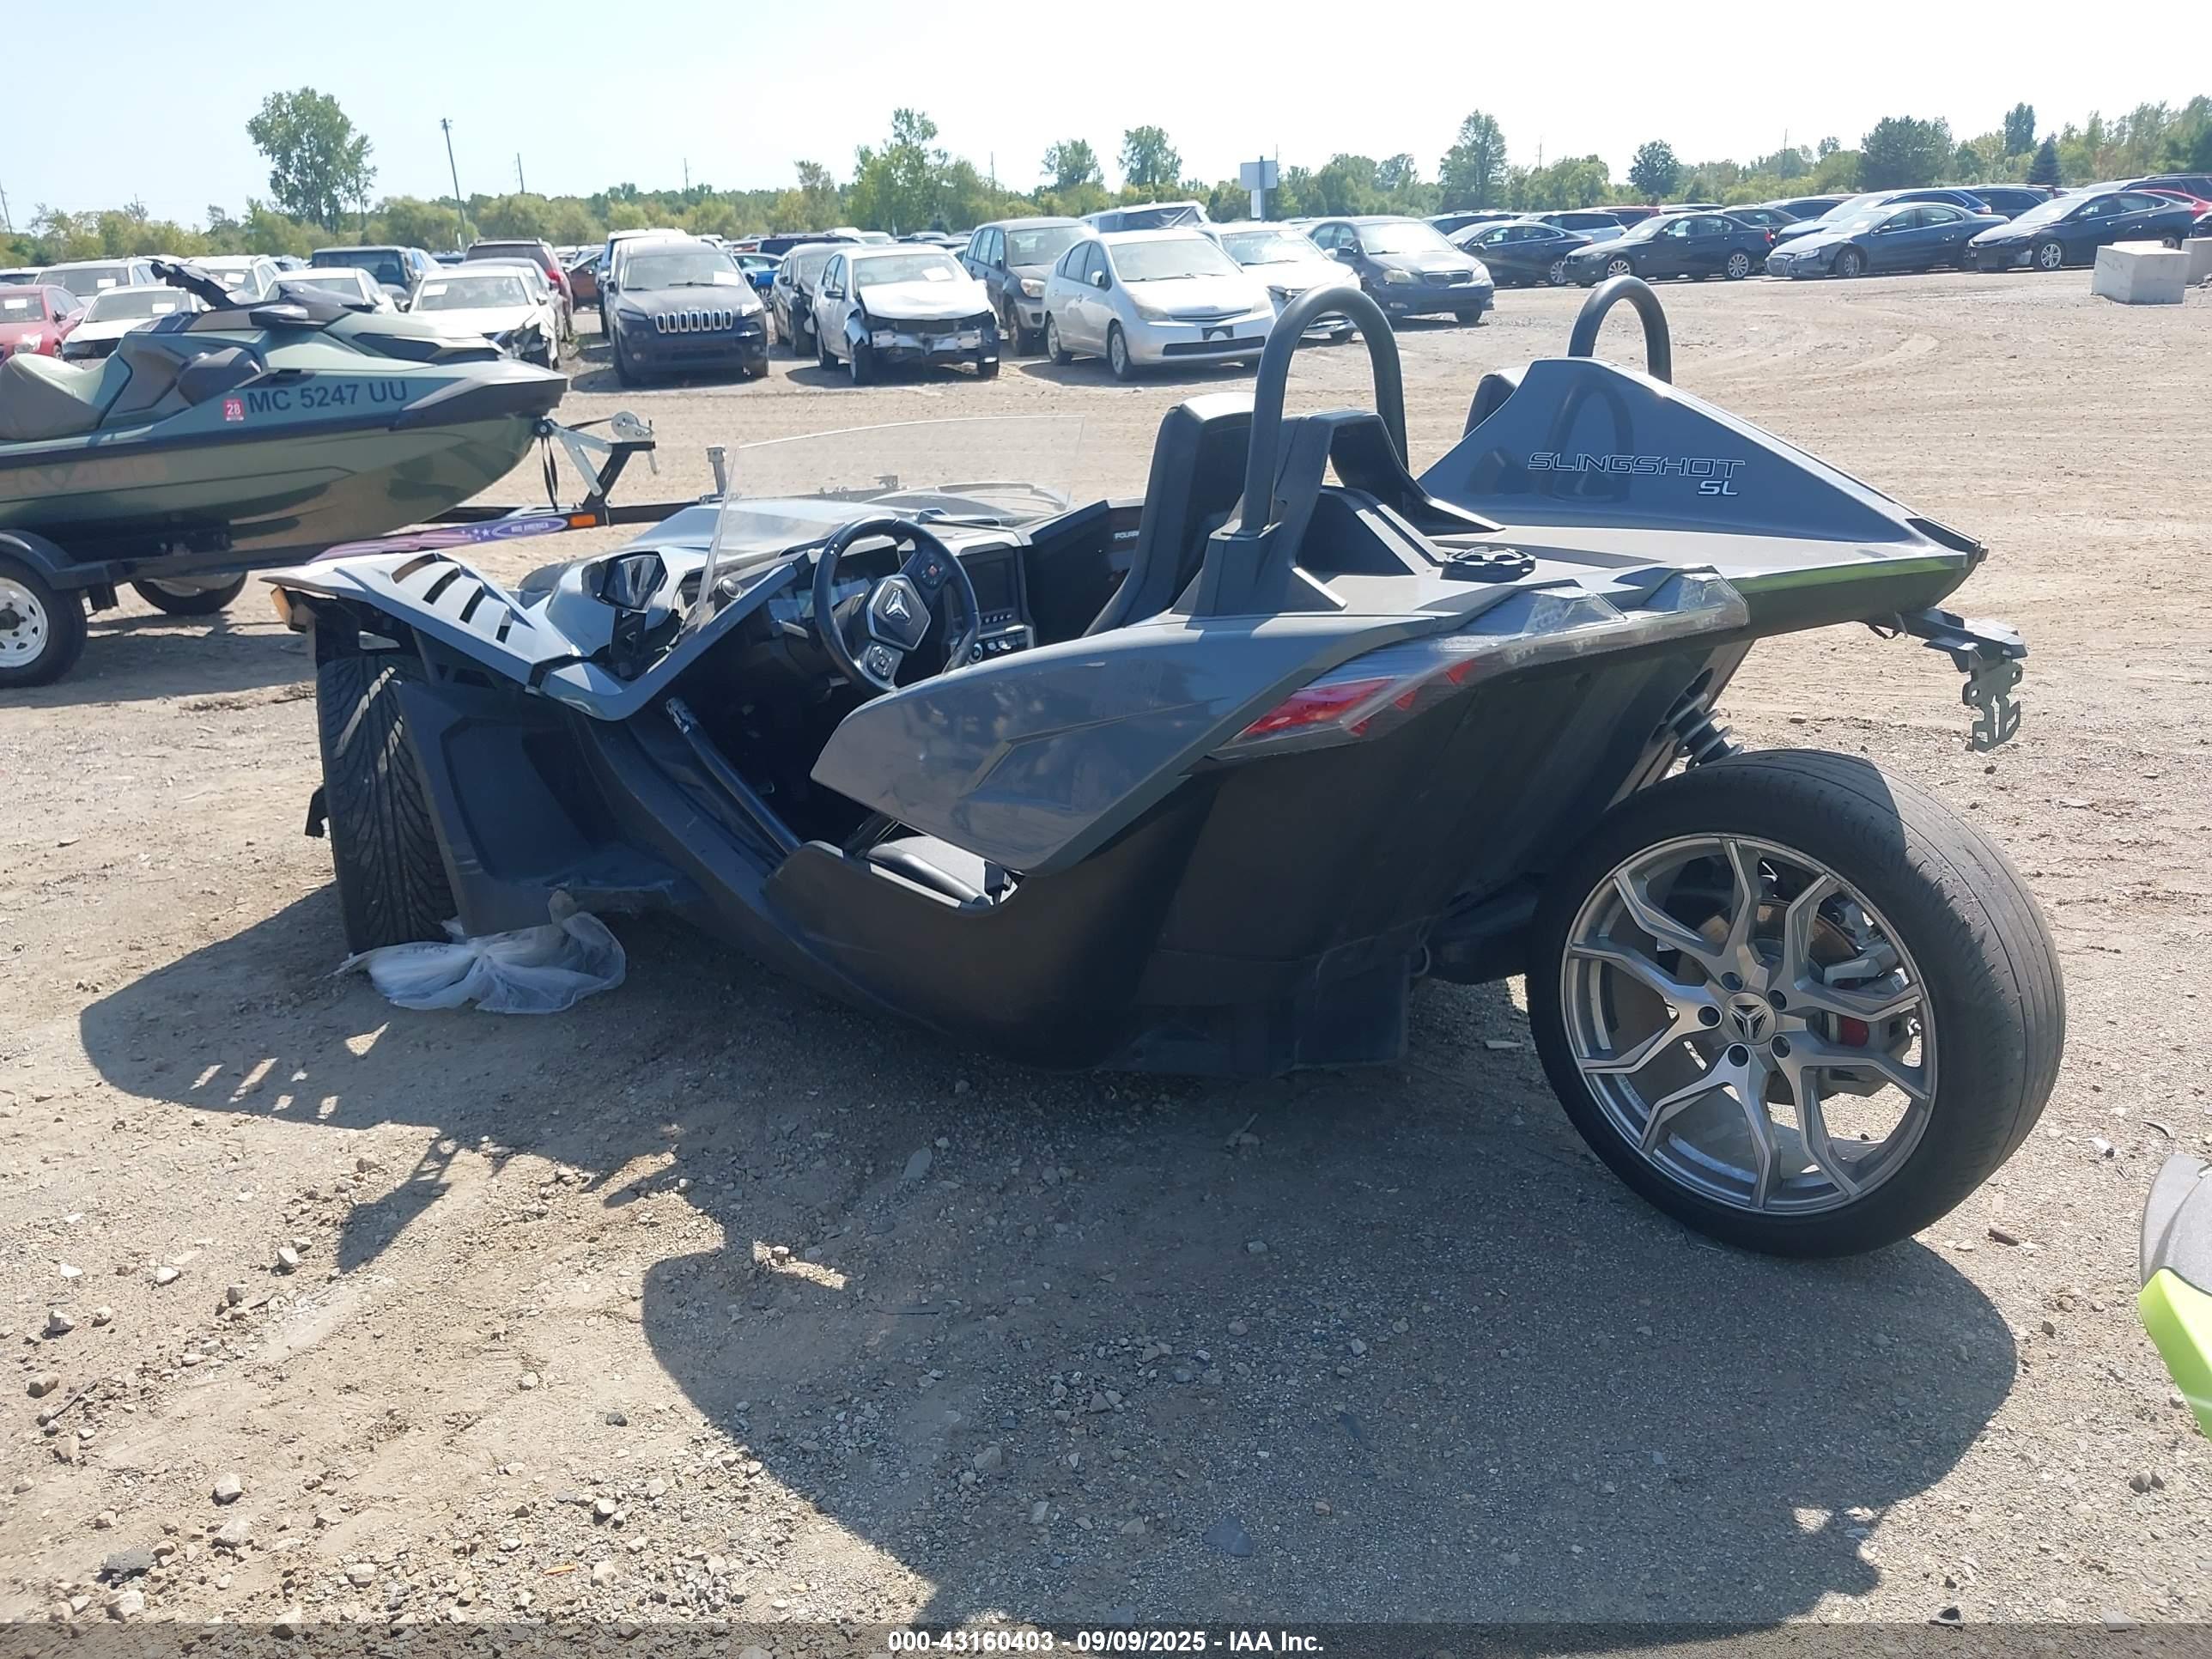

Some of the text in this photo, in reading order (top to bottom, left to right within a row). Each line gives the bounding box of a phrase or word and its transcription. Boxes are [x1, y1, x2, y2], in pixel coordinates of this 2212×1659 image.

[247, 380, 408, 413] MC 5247 UU
[227, 403, 241, 415] 28
[1528, 452, 1746, 478] SLINGSHOT
[1697, 480, 1739, 495] SL
